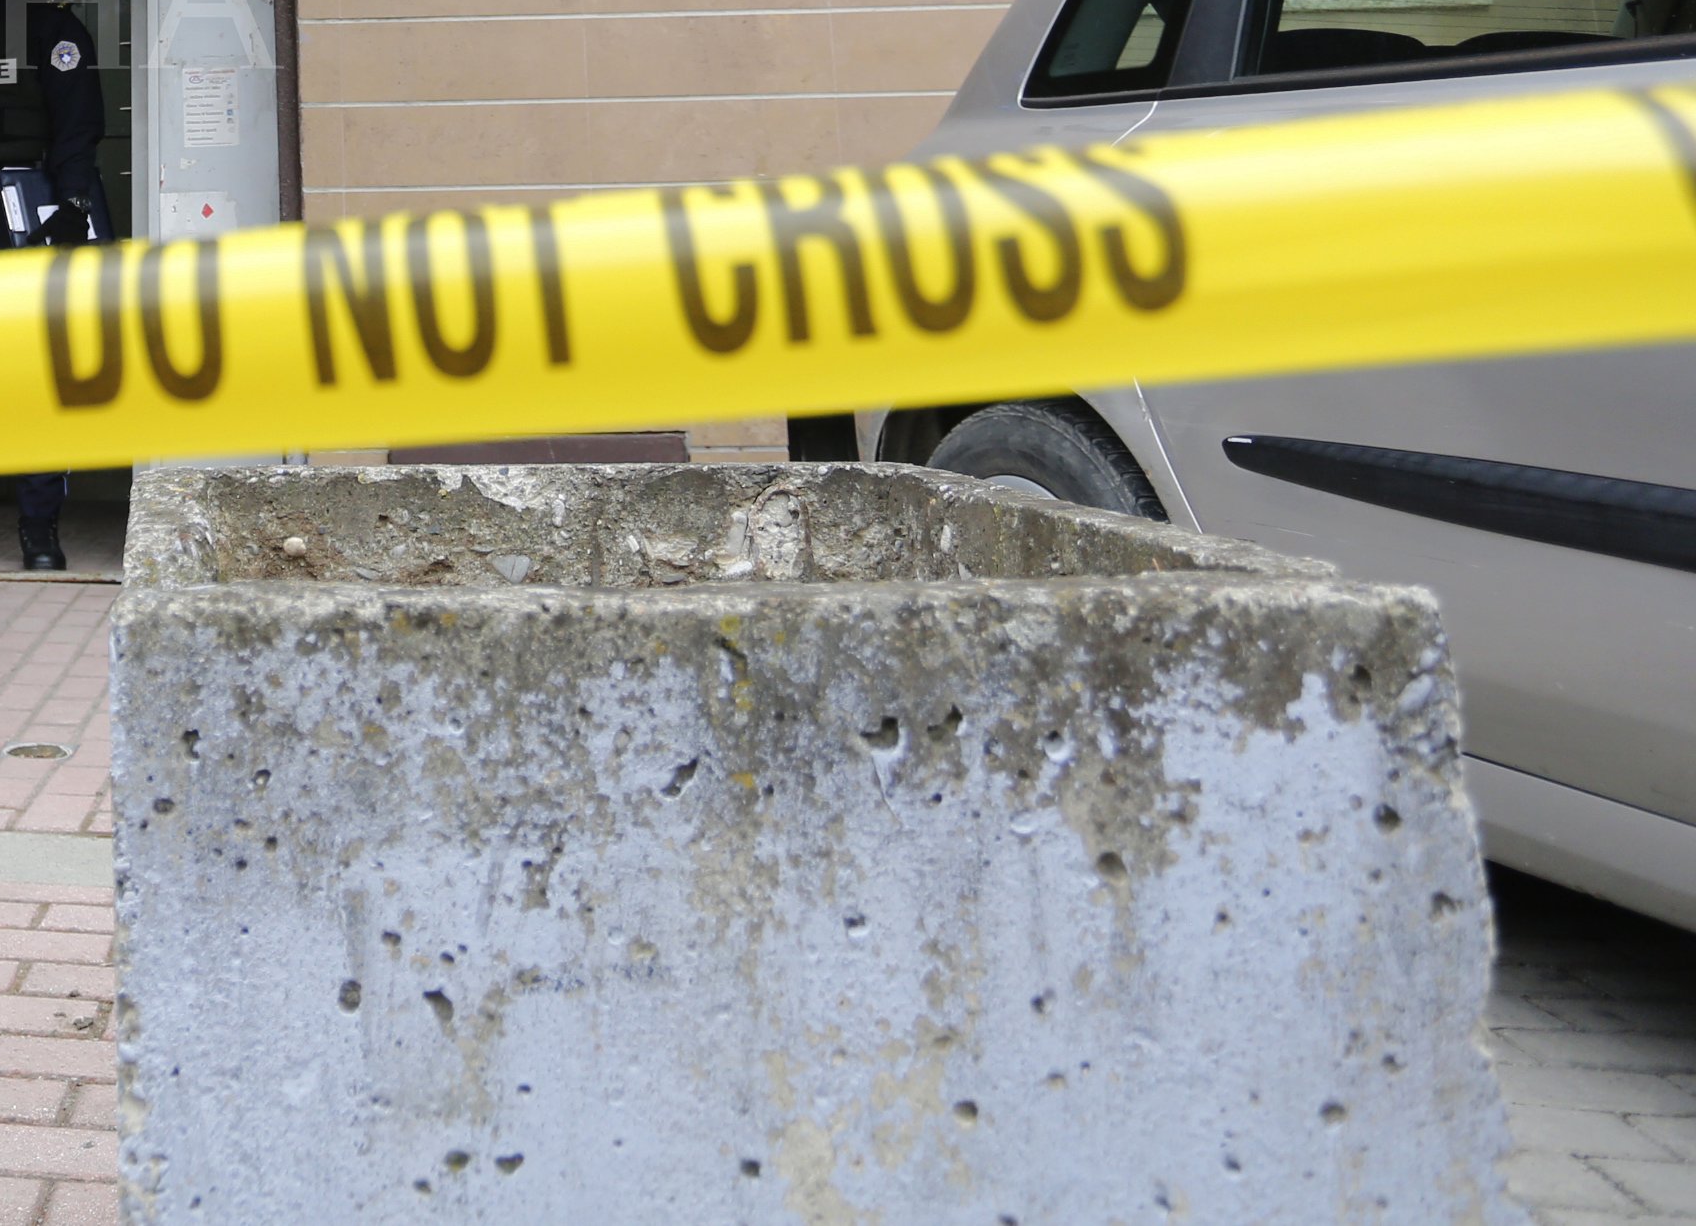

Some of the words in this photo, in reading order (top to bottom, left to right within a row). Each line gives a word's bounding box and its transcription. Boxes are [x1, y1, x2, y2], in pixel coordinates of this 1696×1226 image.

[44, 242, 224, 409] DO
[302, 209, 573, 387] NOT
[658, 146, 1190, 354] CROSS
